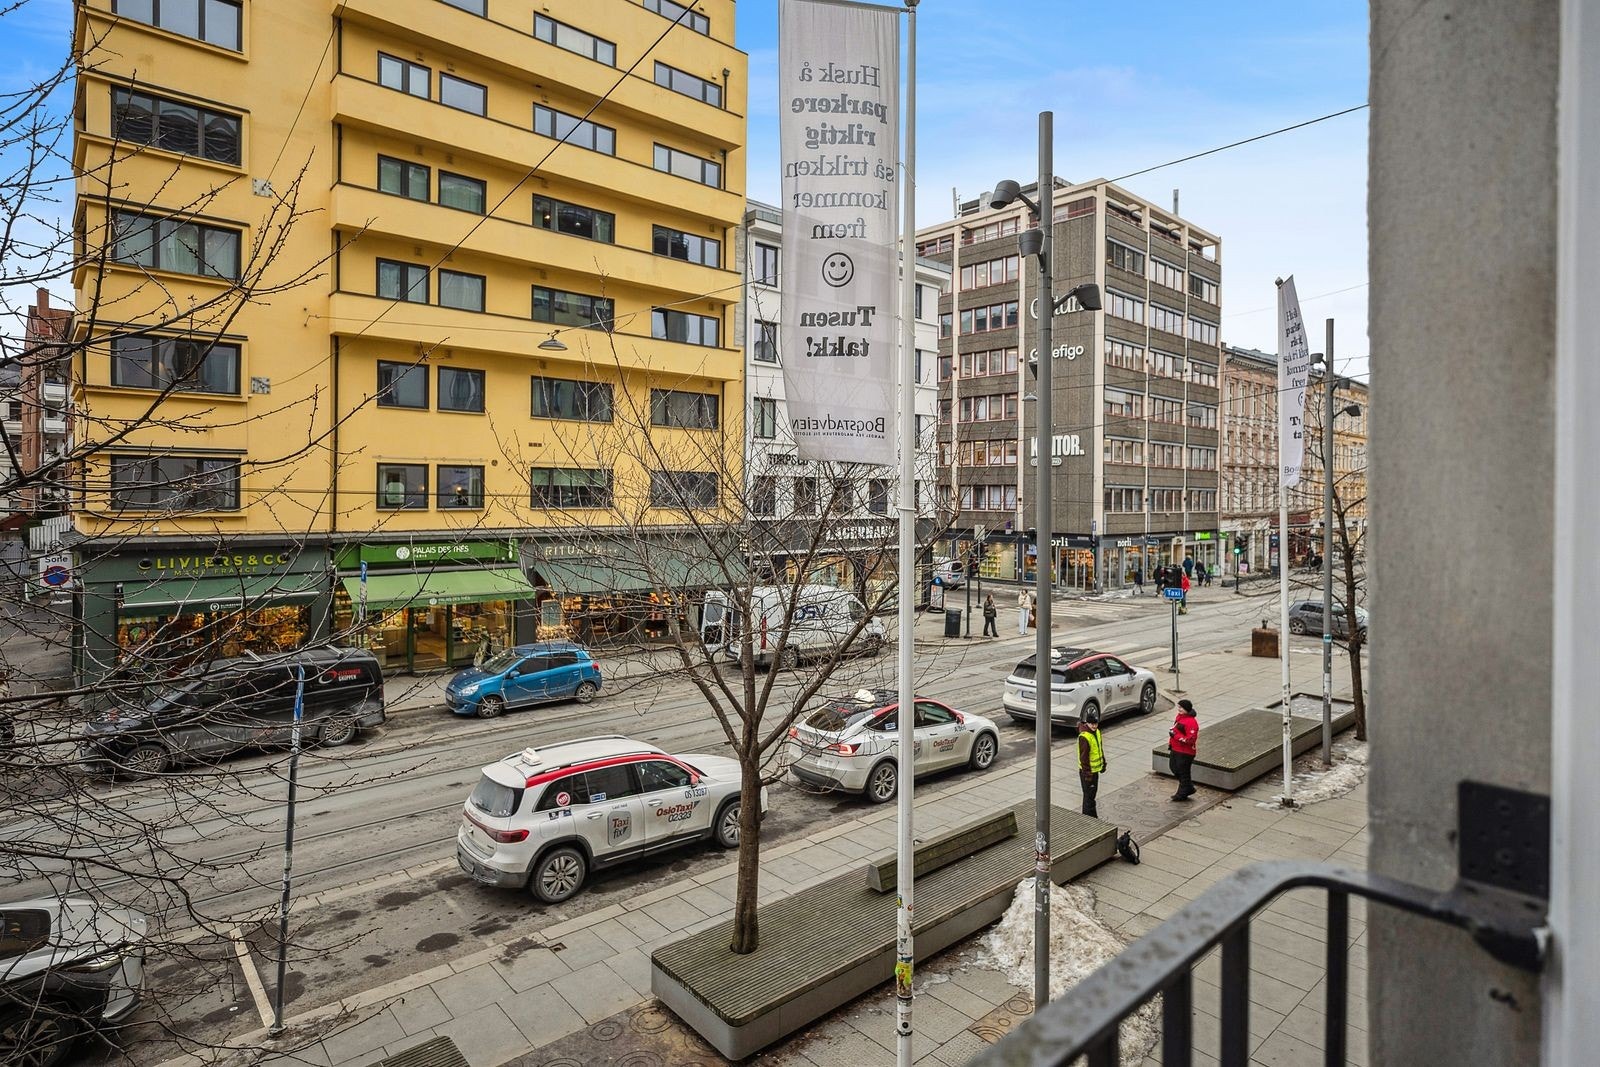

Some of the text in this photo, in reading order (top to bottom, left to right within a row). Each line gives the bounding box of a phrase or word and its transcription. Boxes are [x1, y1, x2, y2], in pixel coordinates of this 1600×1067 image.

[1051, 537, 1069, 547] orli
[1117, 537, 1132, 547] norli
[413, 546, 436, 554] PALAIS
[438, 546, 451, 554] DES
[656, 802, 693, 817] OsloTaxi
[668, 811, 692, 822] 02323
[612, 817, 630, 829] Taxi
